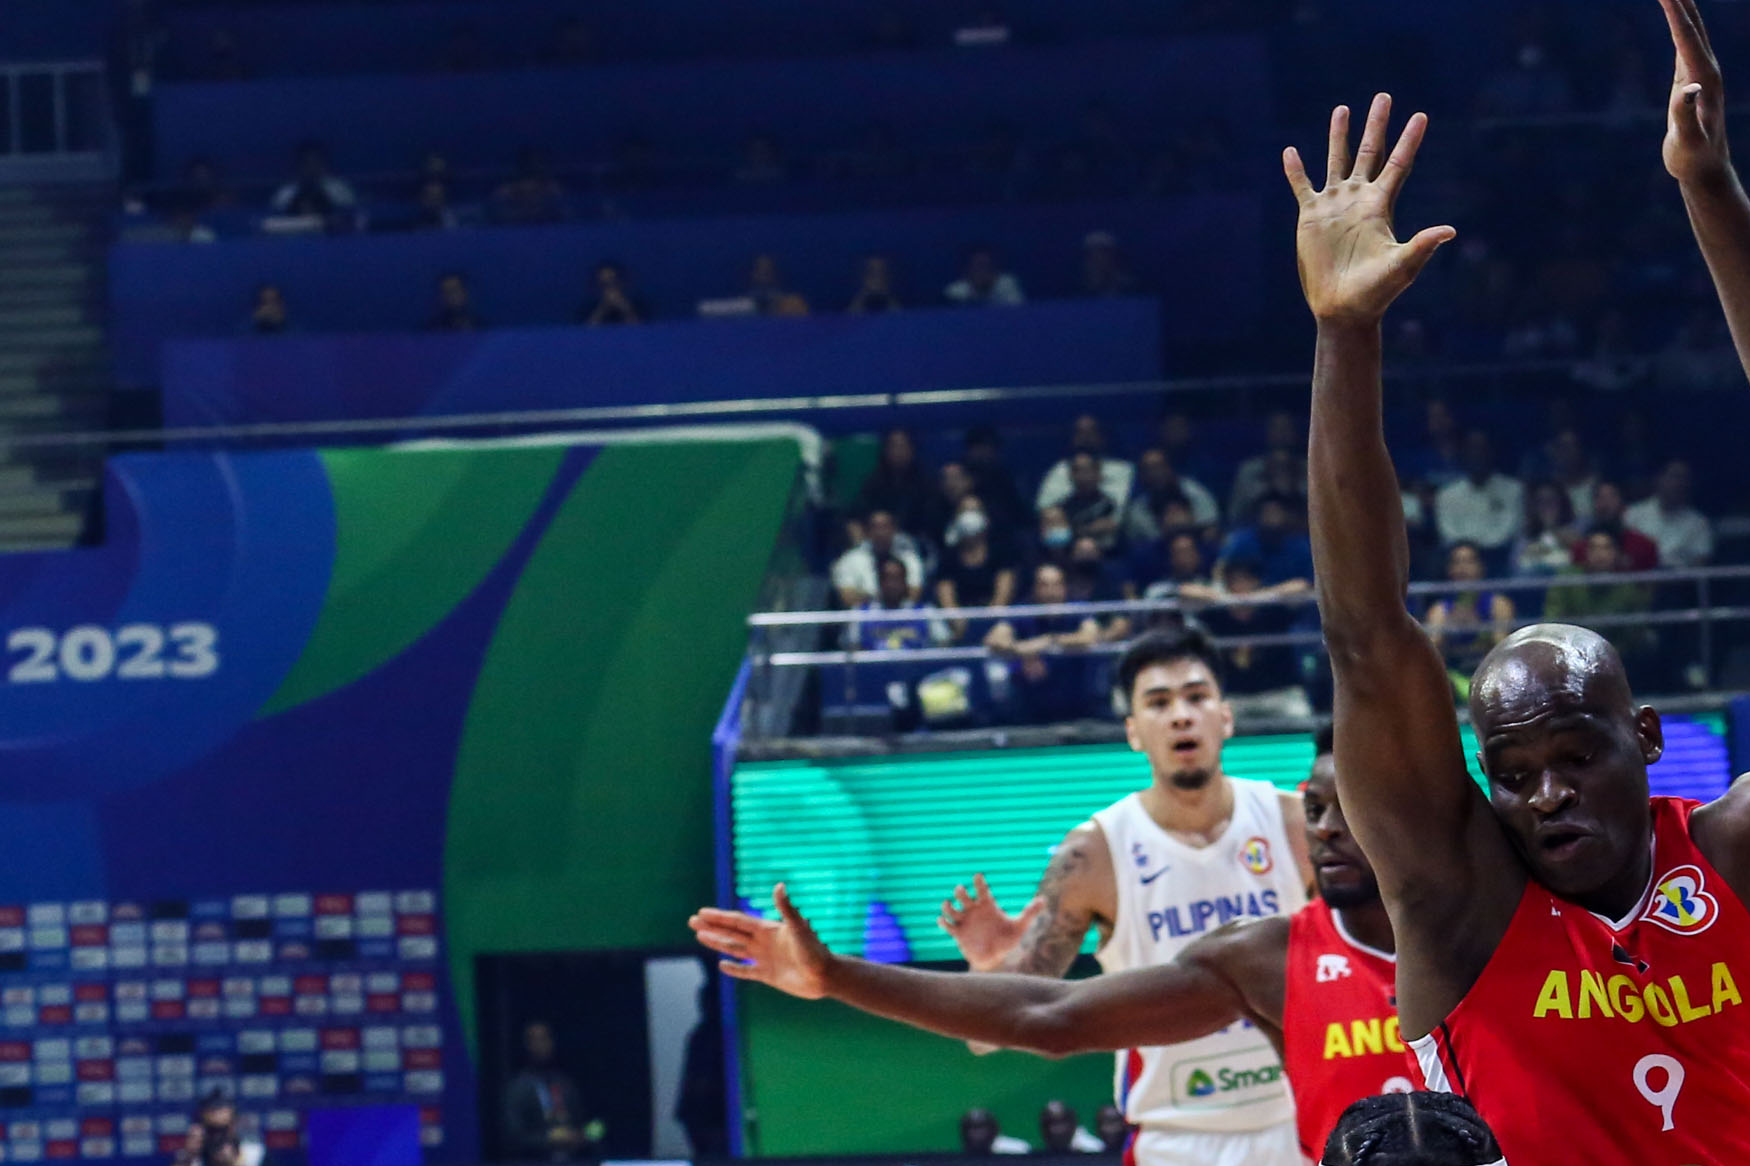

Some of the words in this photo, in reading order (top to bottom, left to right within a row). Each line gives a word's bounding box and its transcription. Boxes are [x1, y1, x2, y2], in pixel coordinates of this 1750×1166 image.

[7, 624, 219, 682] 2023
[1533, 962, 1742, 1027] ANGOLA
[1323, 1017, 1405, 1060] ANG
[1218, 1065, 1281, 1091] Smar
[1633, 1053, 1685, 1132] 9
